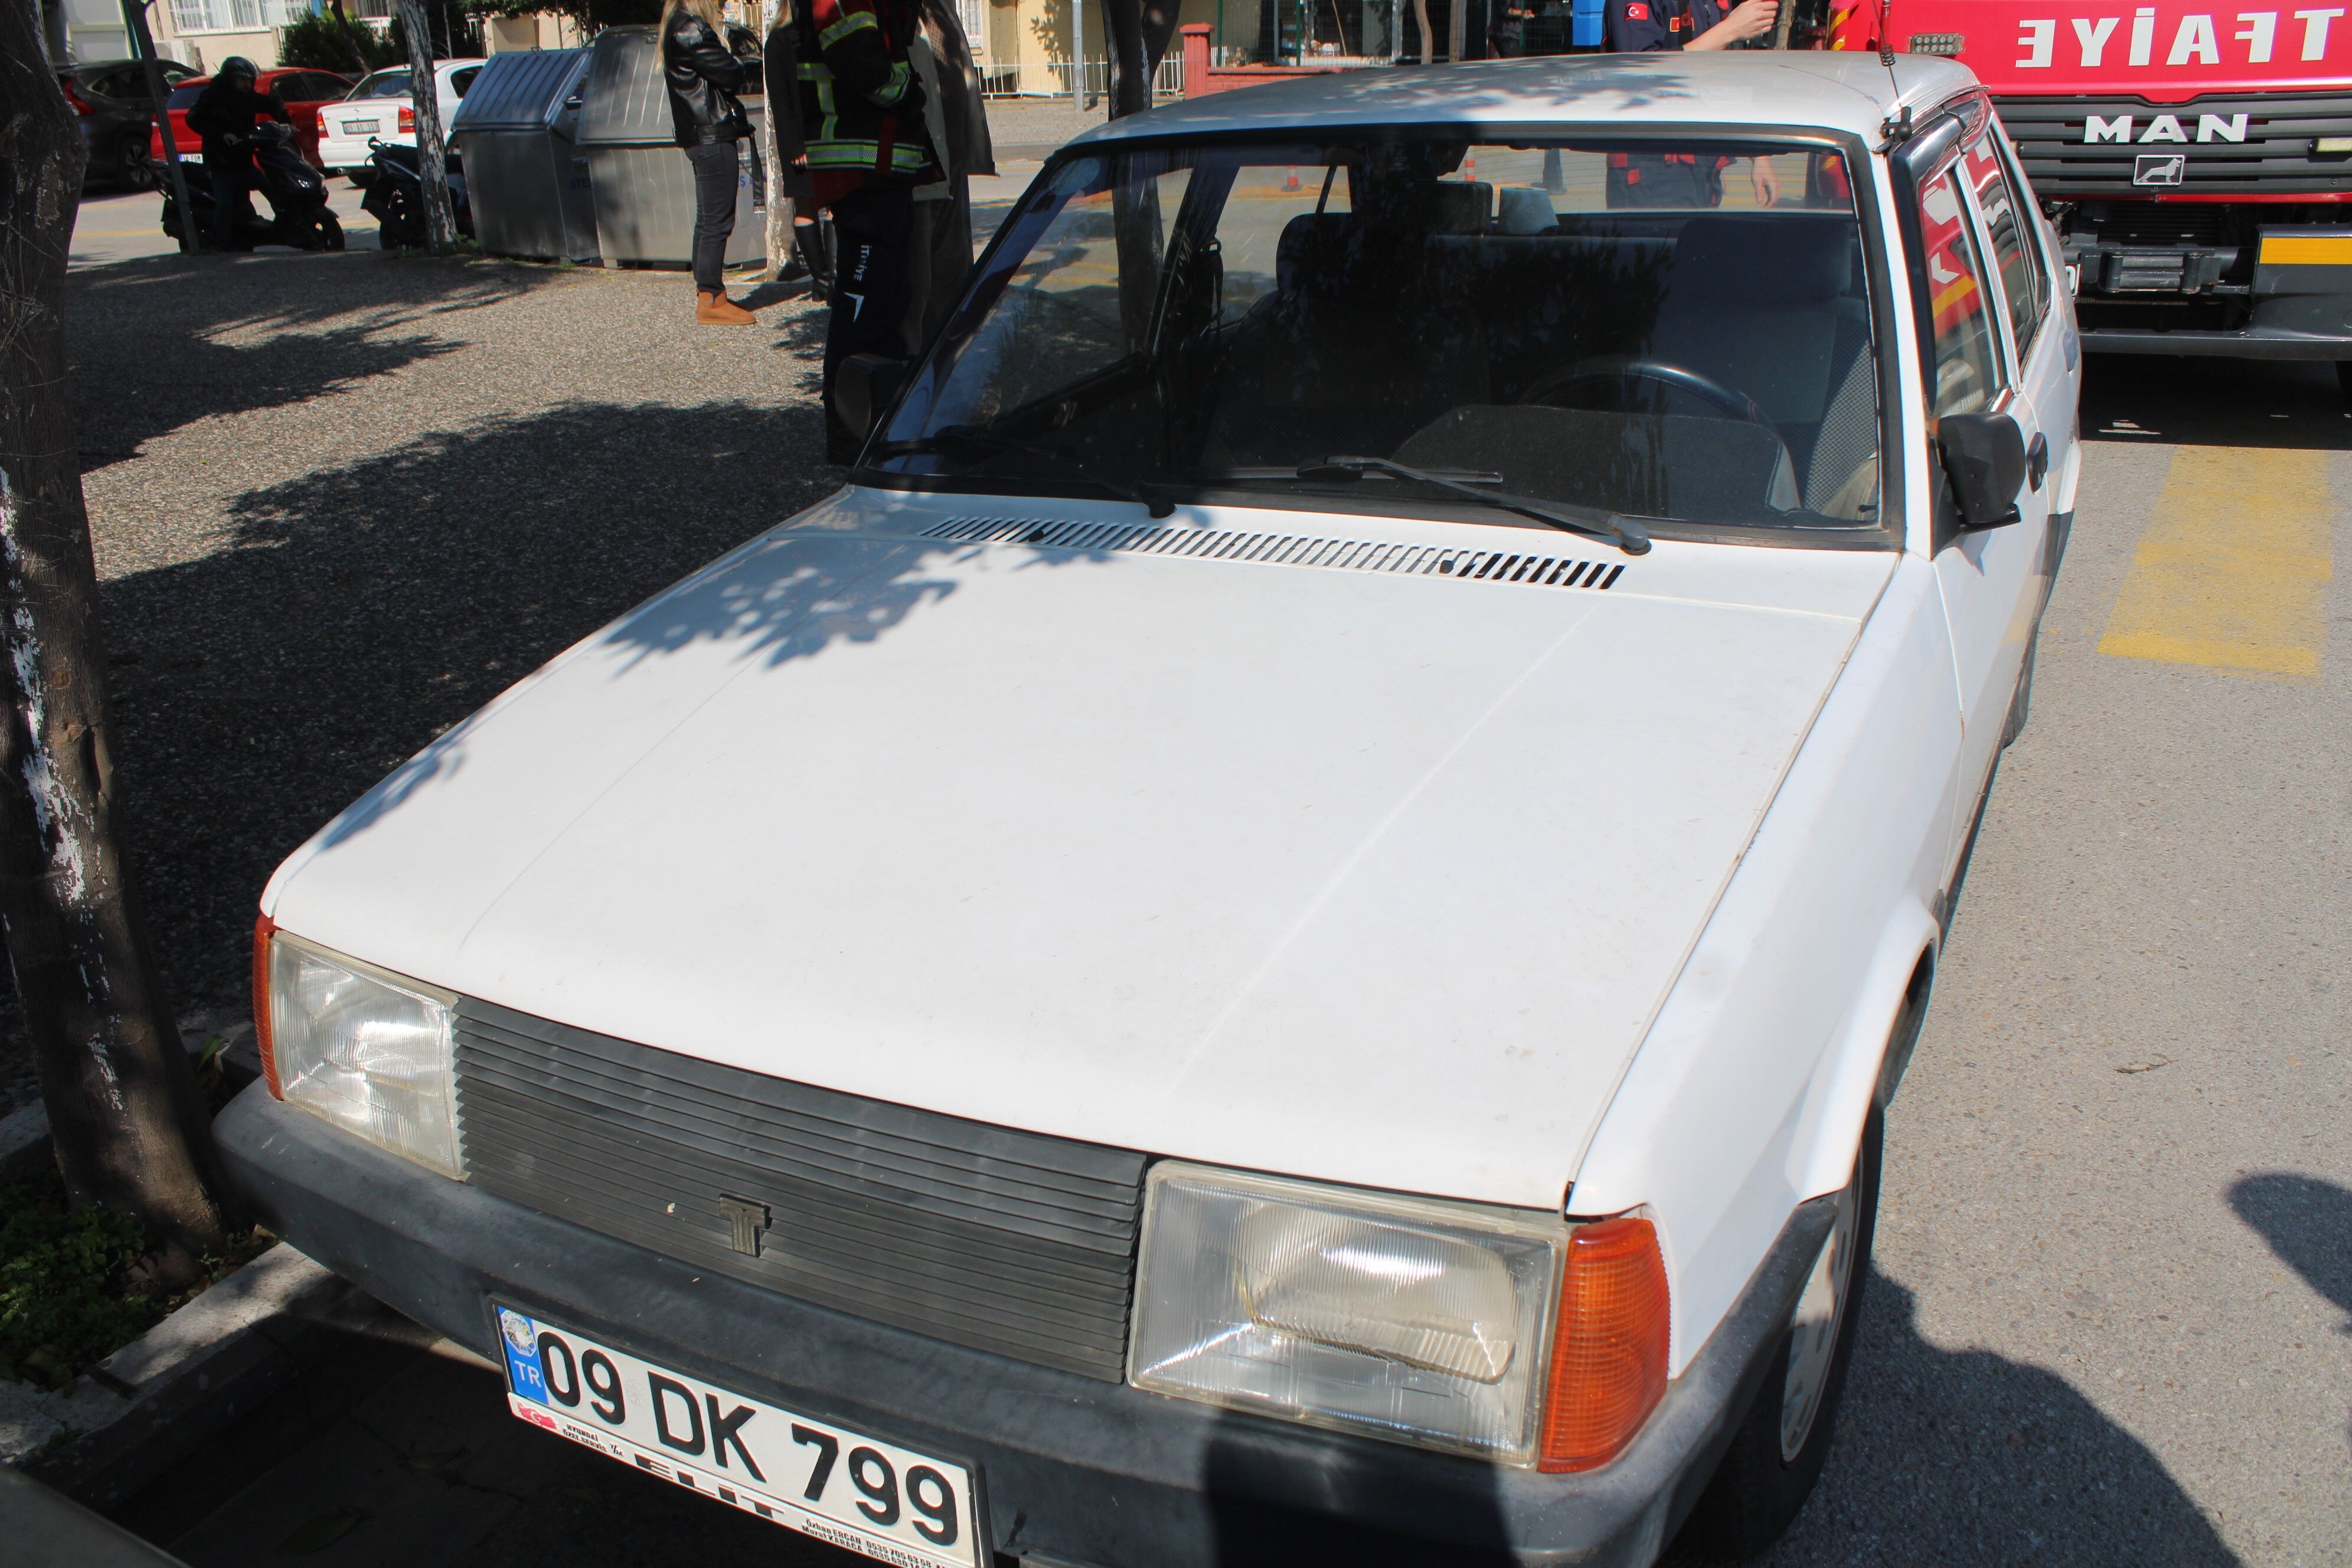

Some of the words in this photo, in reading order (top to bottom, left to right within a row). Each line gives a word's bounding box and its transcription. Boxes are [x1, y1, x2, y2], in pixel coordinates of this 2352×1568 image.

[2083, 113, 2249, 143] MAN
[514, 1360, 542, 1388] TR
[537, 1331, 626, 1425] 09
[648, 1369, 766, 1483] DK
[790, 1422, 958, 1546] 799
[802, 1525, 827, 1538] Murat
[828, 1534, 863, 1552] KARACA
[868, 1549, 890, 1562] 0535
[806, 1517, 832, 1533] Özhan
[833, 1529, 861, 1544] ERCAN
[867, 1540, 888, 1554] 0535
